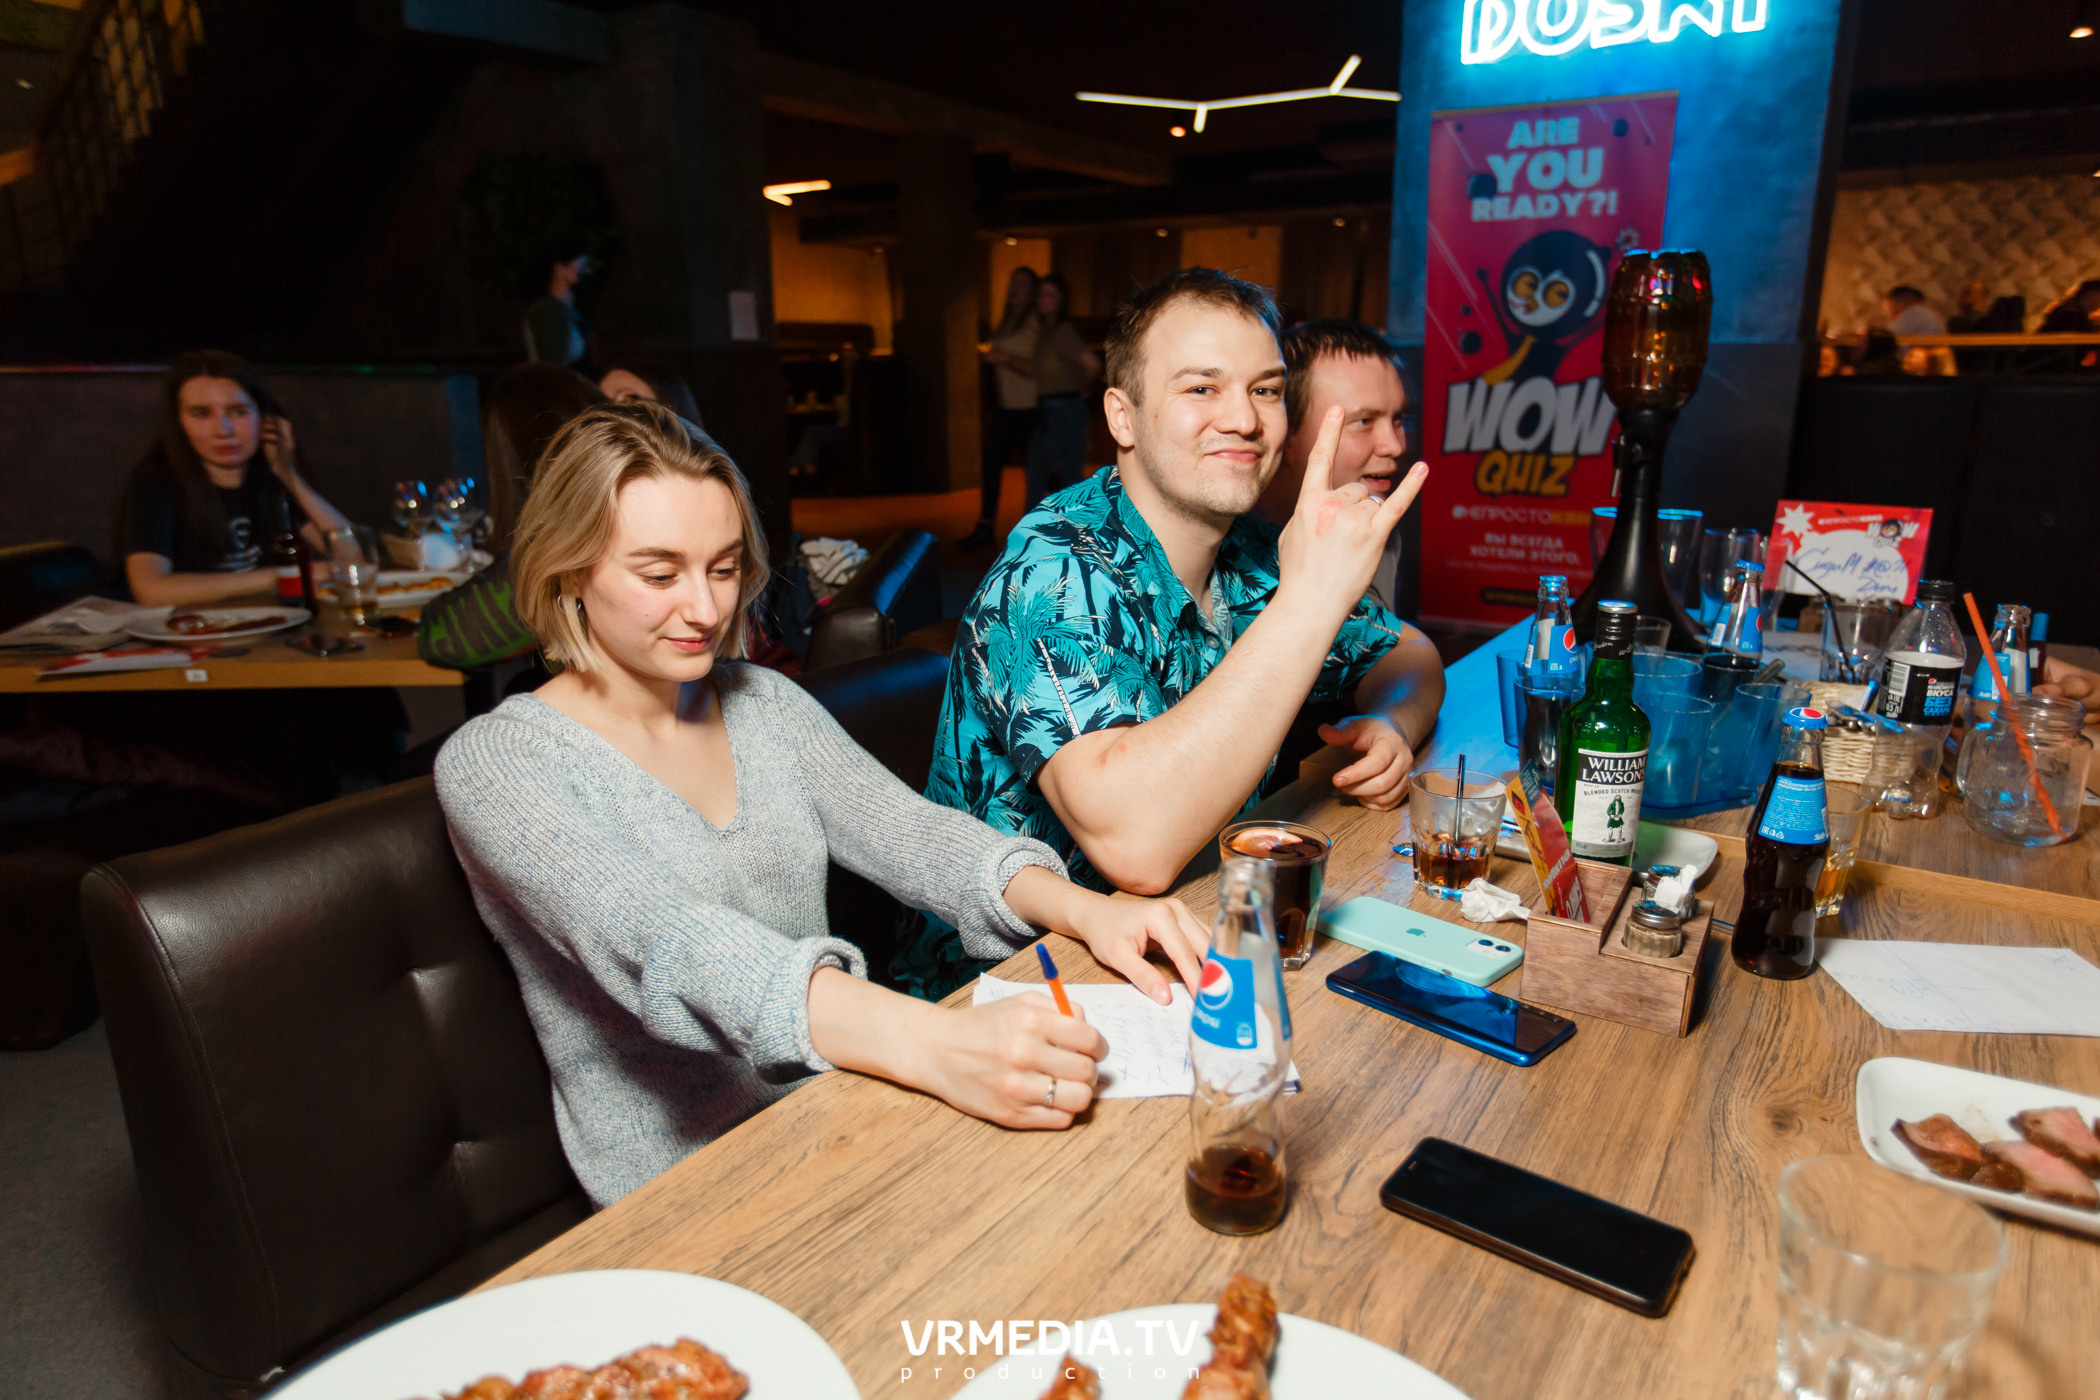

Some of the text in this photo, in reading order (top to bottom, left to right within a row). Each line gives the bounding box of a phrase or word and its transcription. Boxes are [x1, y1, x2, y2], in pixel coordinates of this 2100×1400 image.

[1507, 117, 1580, 149] ARE
[1487, 148, 1605, 193] YOU
[1471, 190, 1618, 222] READY?!
[1444, 376, 1617, 455] WOW
[1476, 450, 1575, 495] QUIZ
[1588, 756, 1646, 771] WILLIAM
[1610, 787, 1630, 795] SCOTCH
